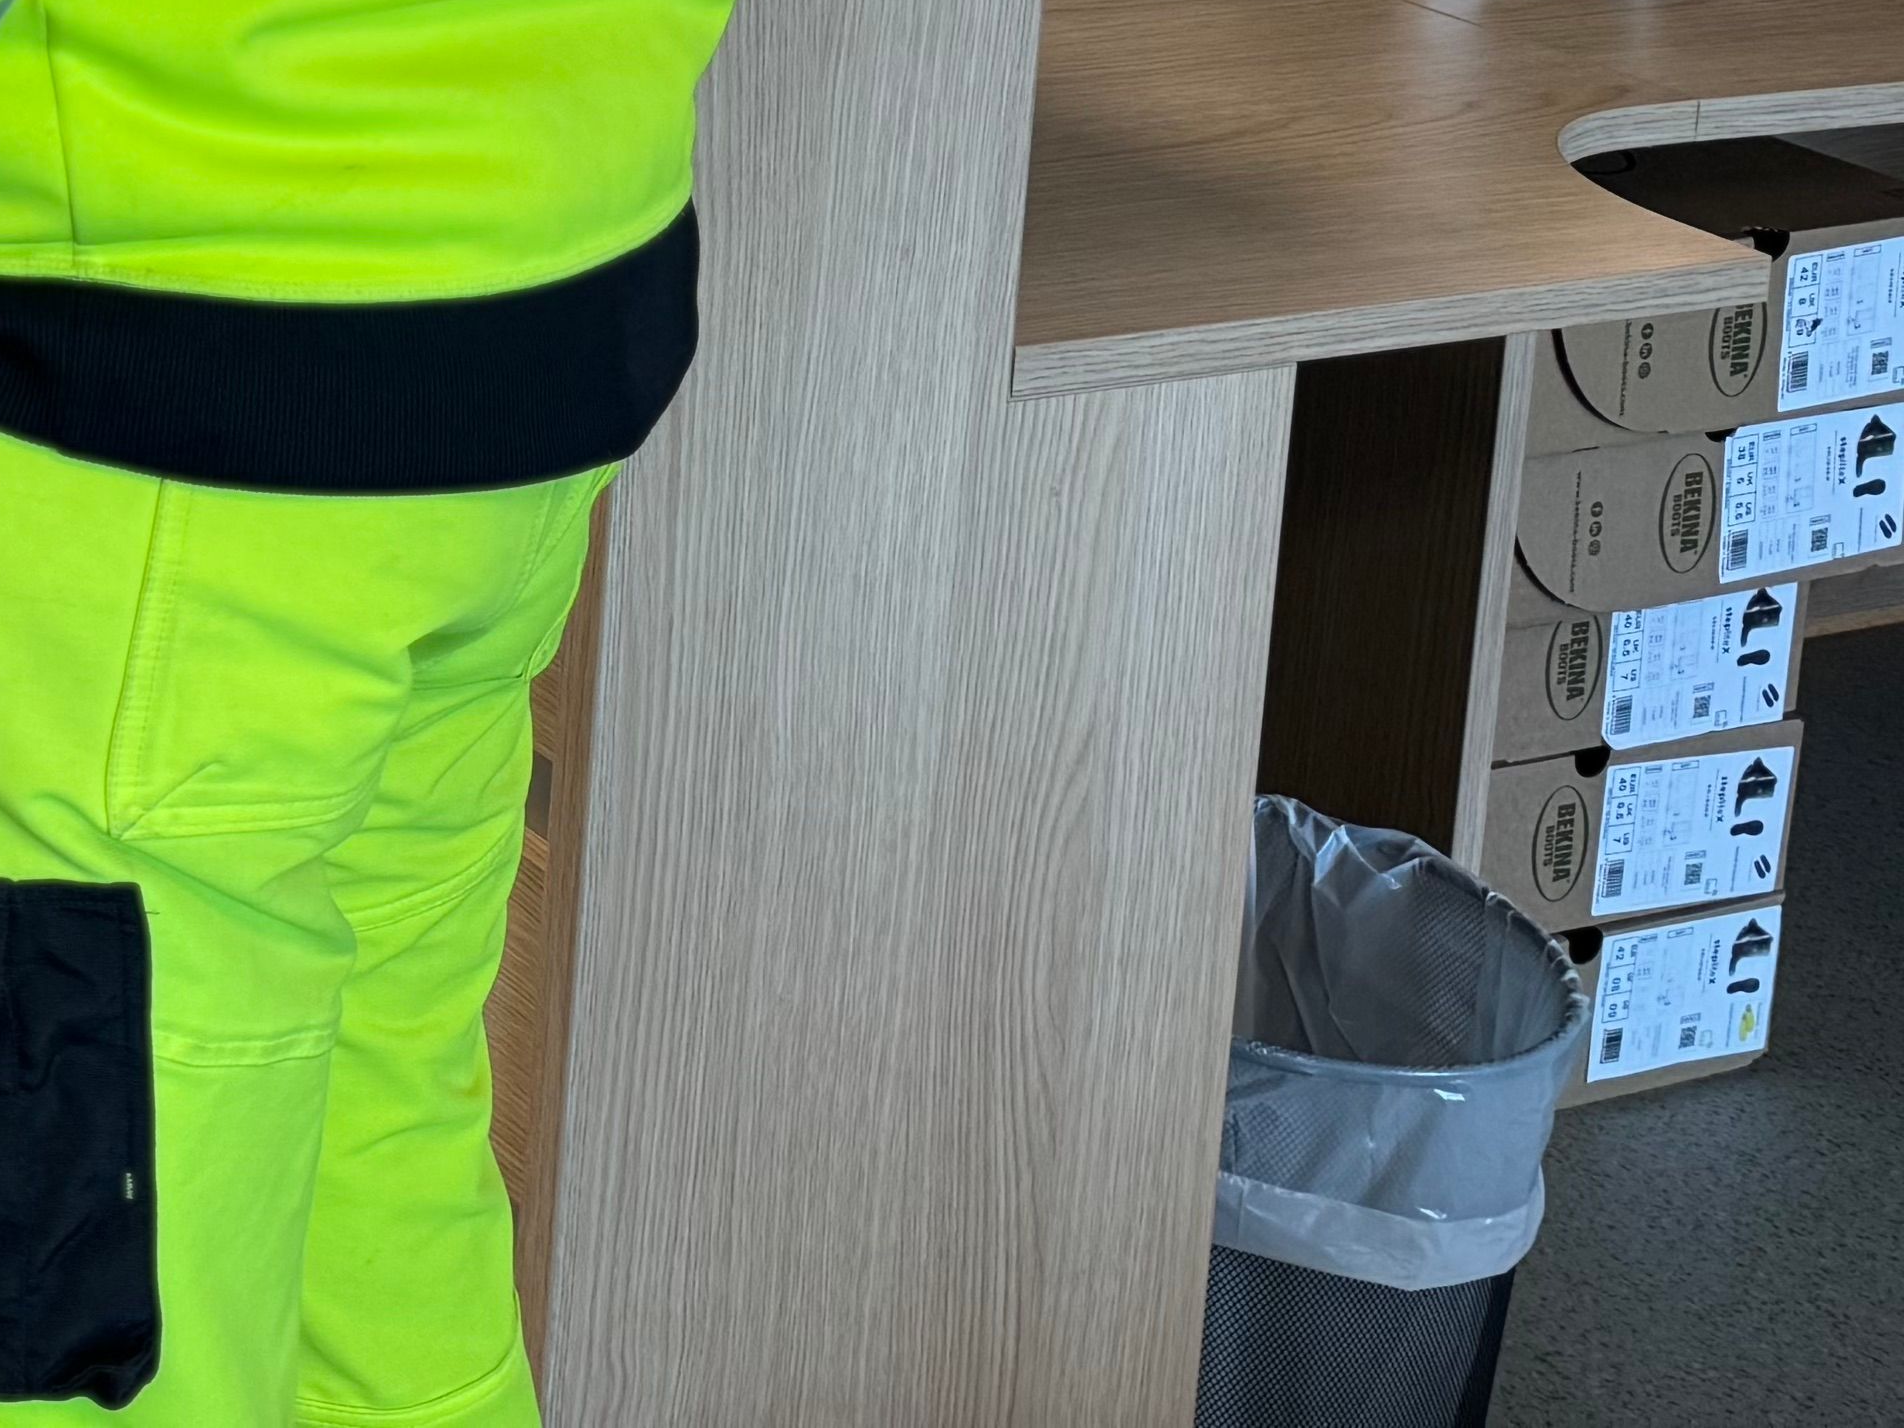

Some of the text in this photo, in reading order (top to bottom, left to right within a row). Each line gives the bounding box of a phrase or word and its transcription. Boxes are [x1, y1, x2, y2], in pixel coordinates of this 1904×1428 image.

[1720, 316, 1733, 360] BOOTS
[1729, 303, 1753, 377] EKINA
[1670, 493, 1683, 536] BOOTS
[1679, 471, 1703, 554] BEKINA
[1623, 613, 1633, 628] 40
[1557, 643, 1569, 686] BOOTS
[1566, 620, 1590, 702] BEKINA
[1618, 777, 1628, 792] 40
[1543, 824, 1556, 867] BOOTS
[1552, 802, 1576, 883] BEKINA
